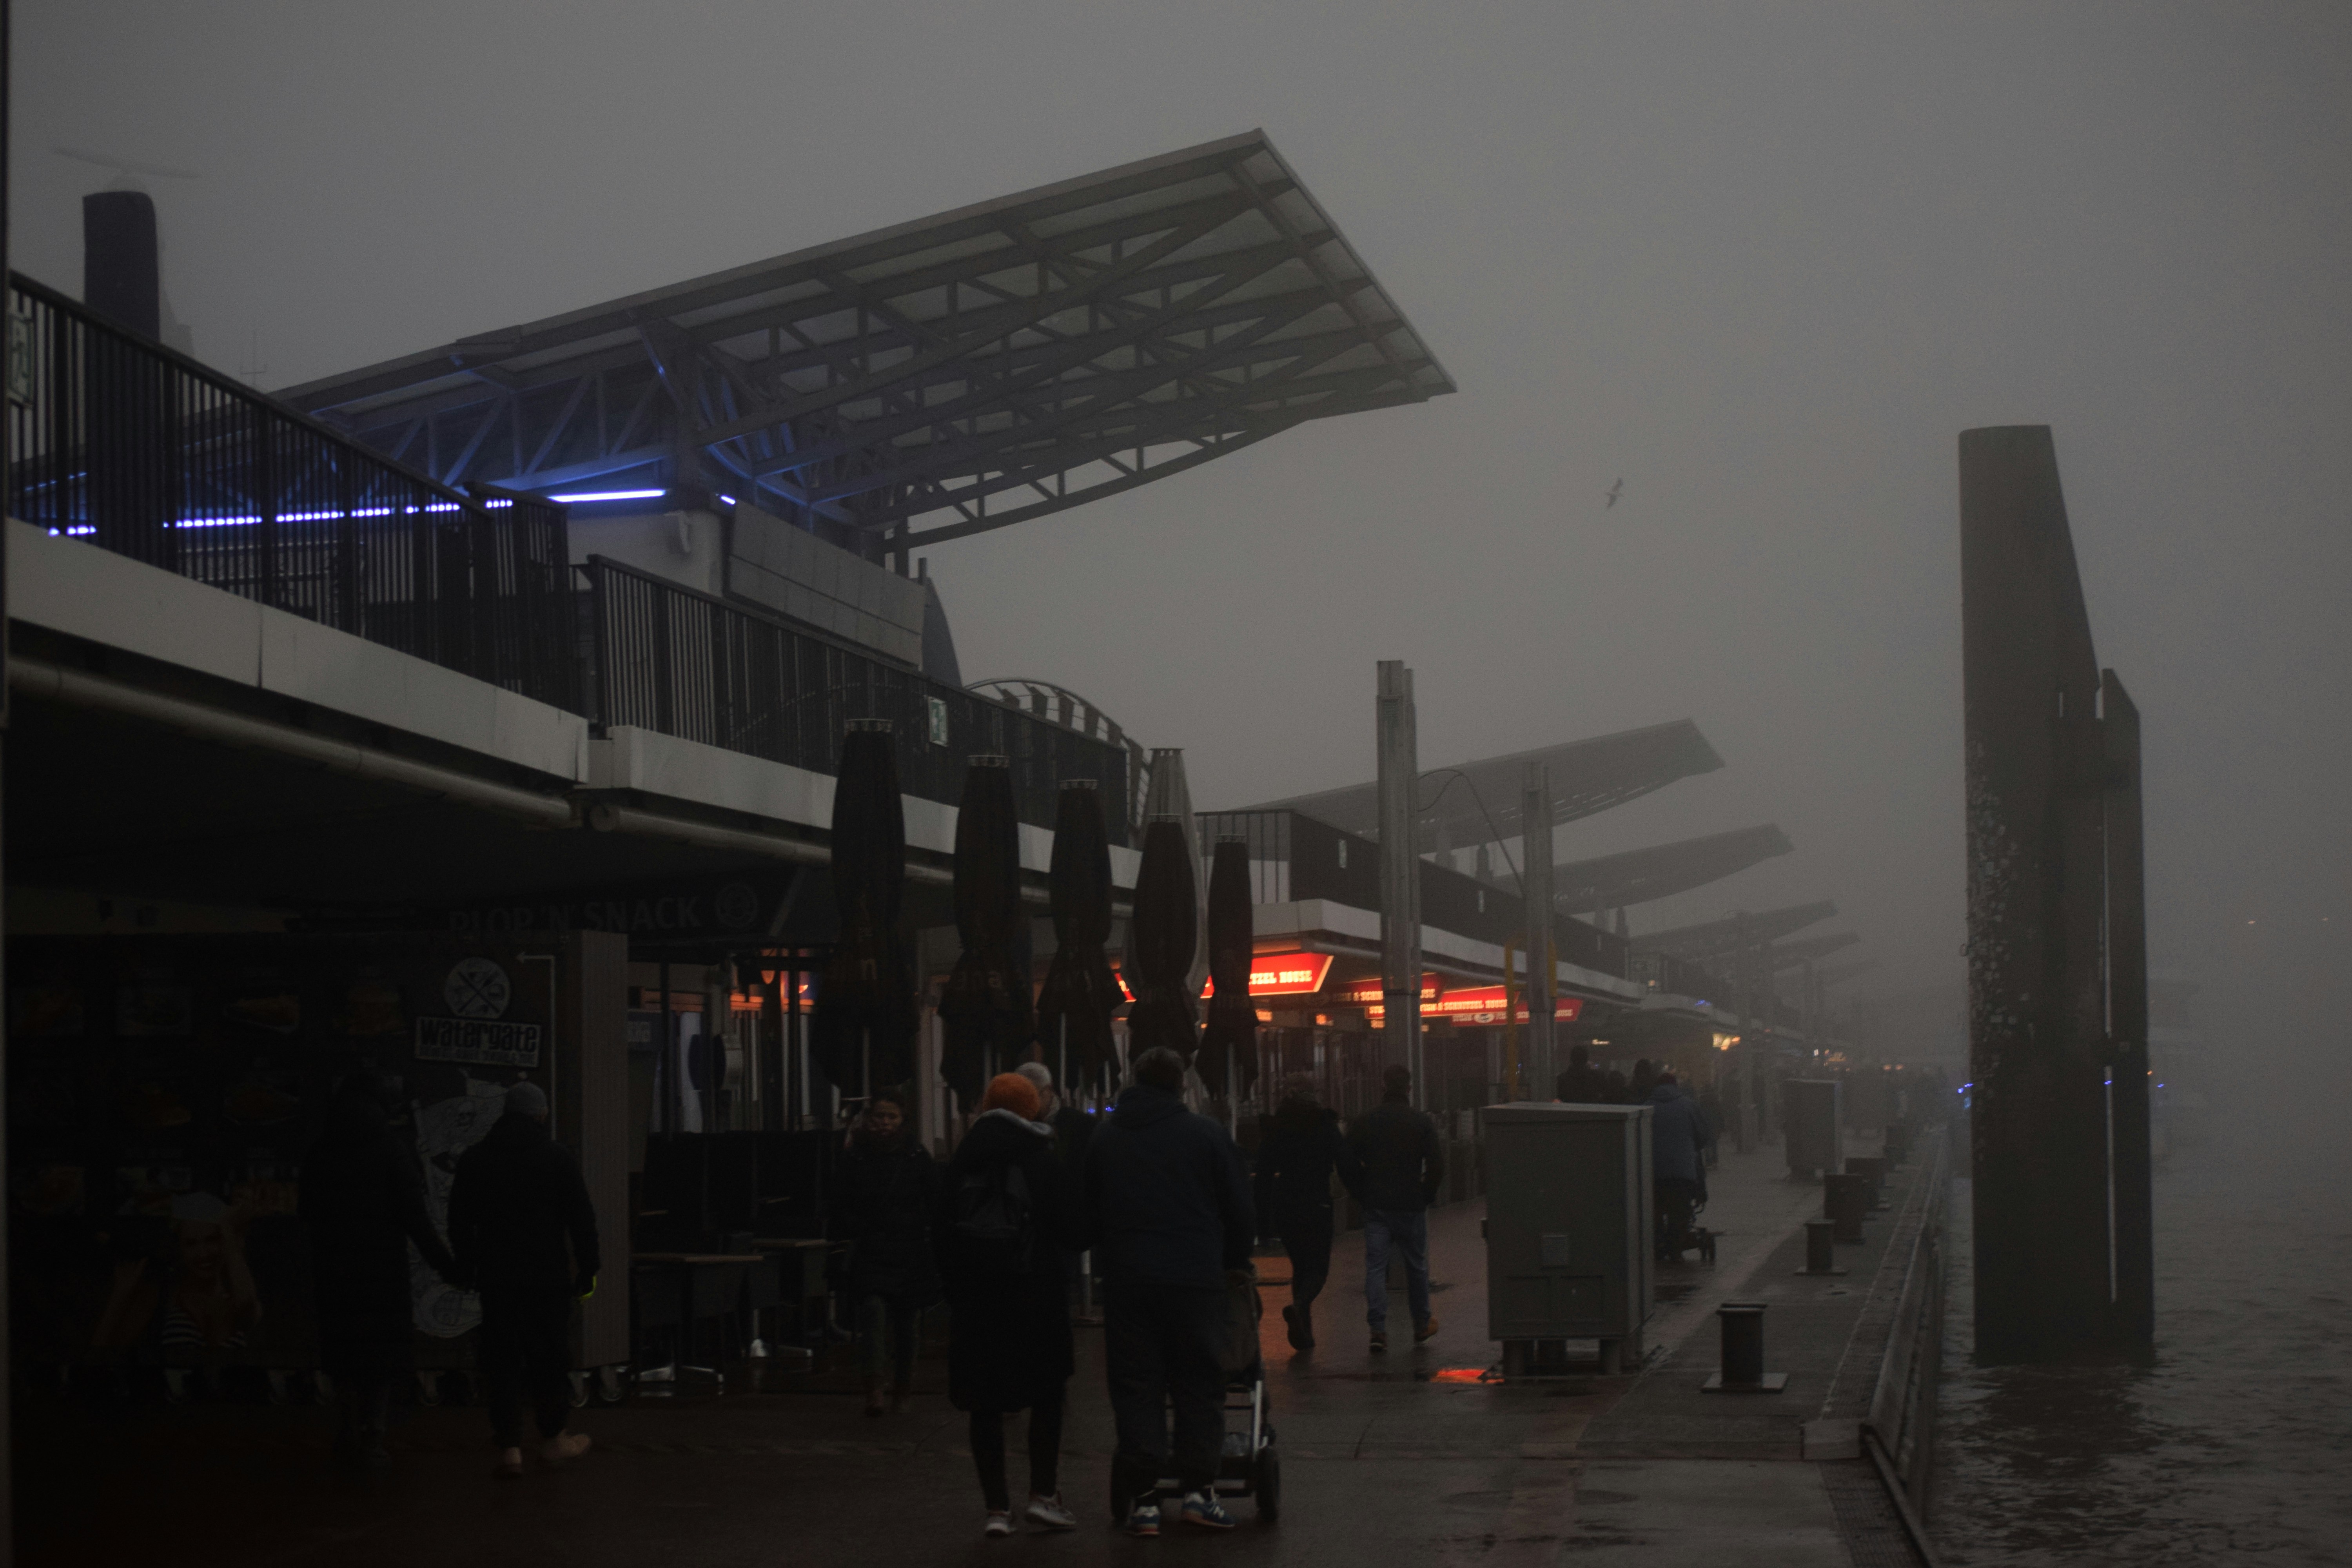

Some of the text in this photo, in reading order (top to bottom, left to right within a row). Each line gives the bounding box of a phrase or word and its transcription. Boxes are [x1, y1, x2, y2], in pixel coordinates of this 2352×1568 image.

[584, 896, 701, 932] SNACK
[1249, 970, 1313, 985] TZEL HOUSE
[1369, 1005, 1385, 1014] STE
[1443, 1000, 1485, 1011] SCHNITZEL
